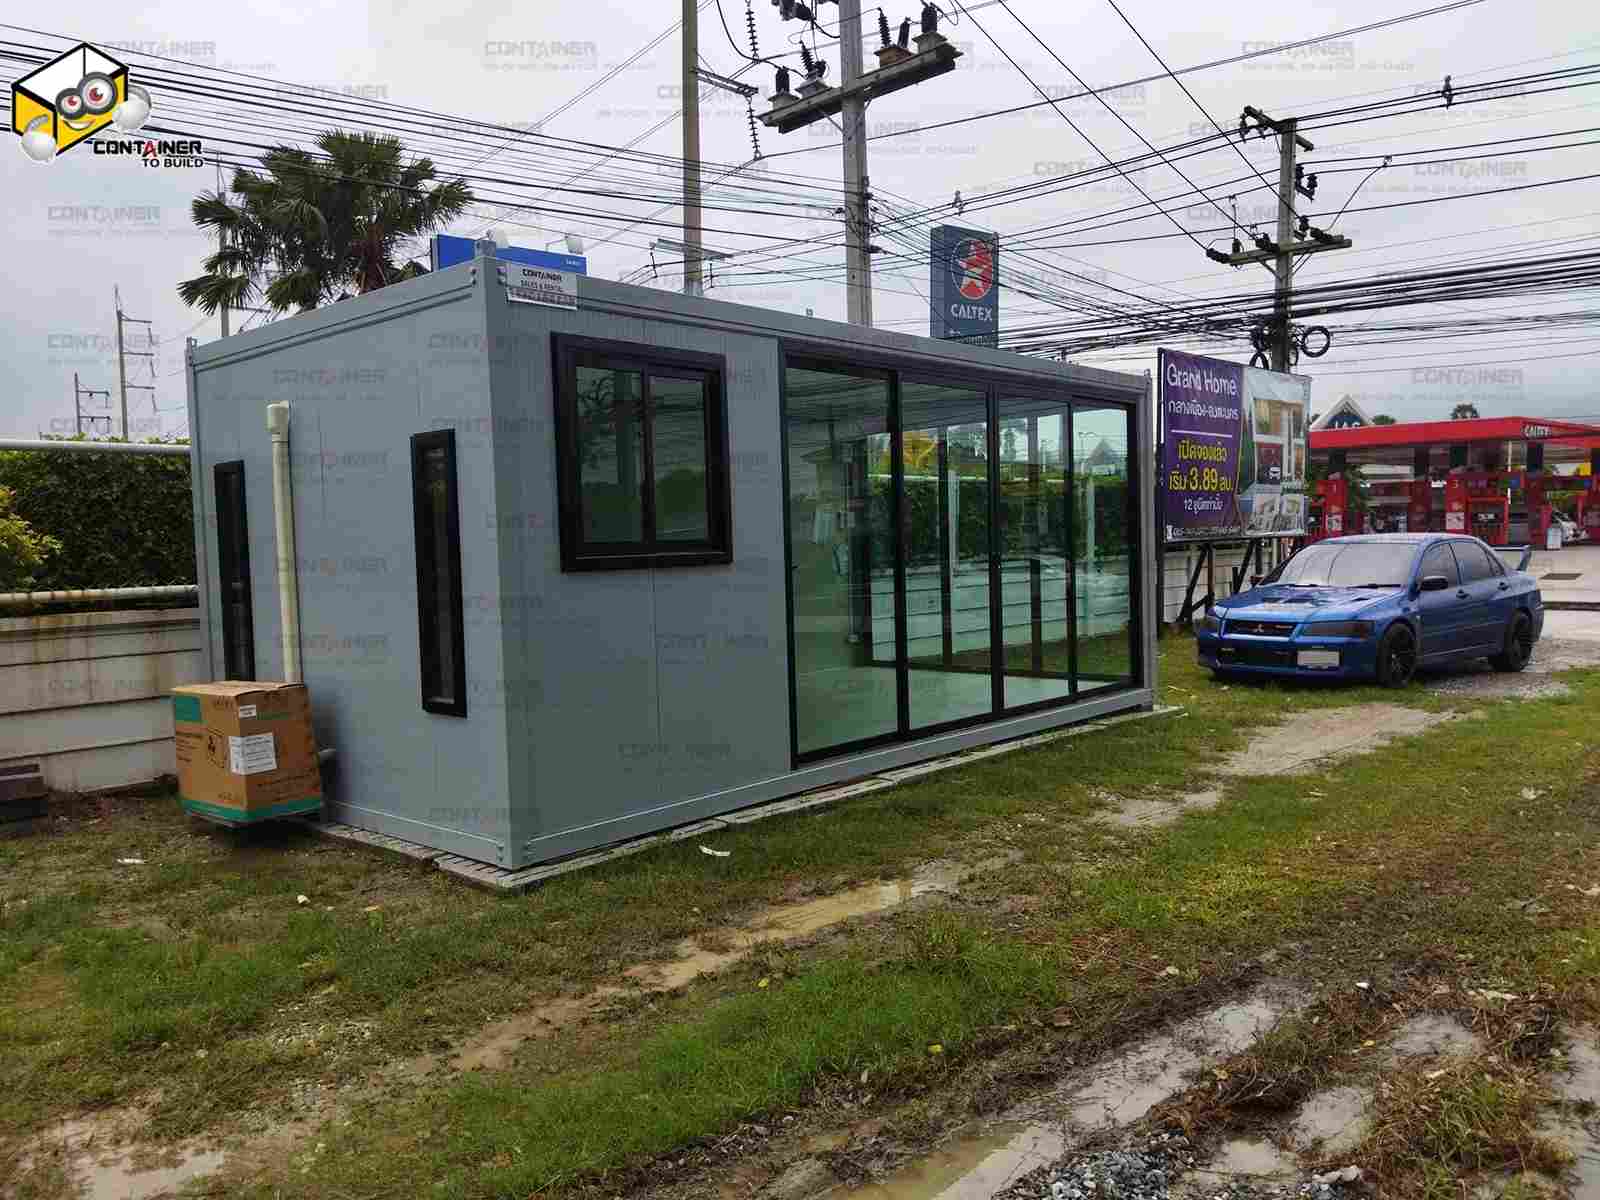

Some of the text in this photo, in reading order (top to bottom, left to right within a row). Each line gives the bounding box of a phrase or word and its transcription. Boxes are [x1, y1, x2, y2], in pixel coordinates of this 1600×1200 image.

[951, 303, 992, 321] CALTEX
[1166, 363, 1237, 395] Grand Home
[1189, 467, 1218, 491] 3.89
